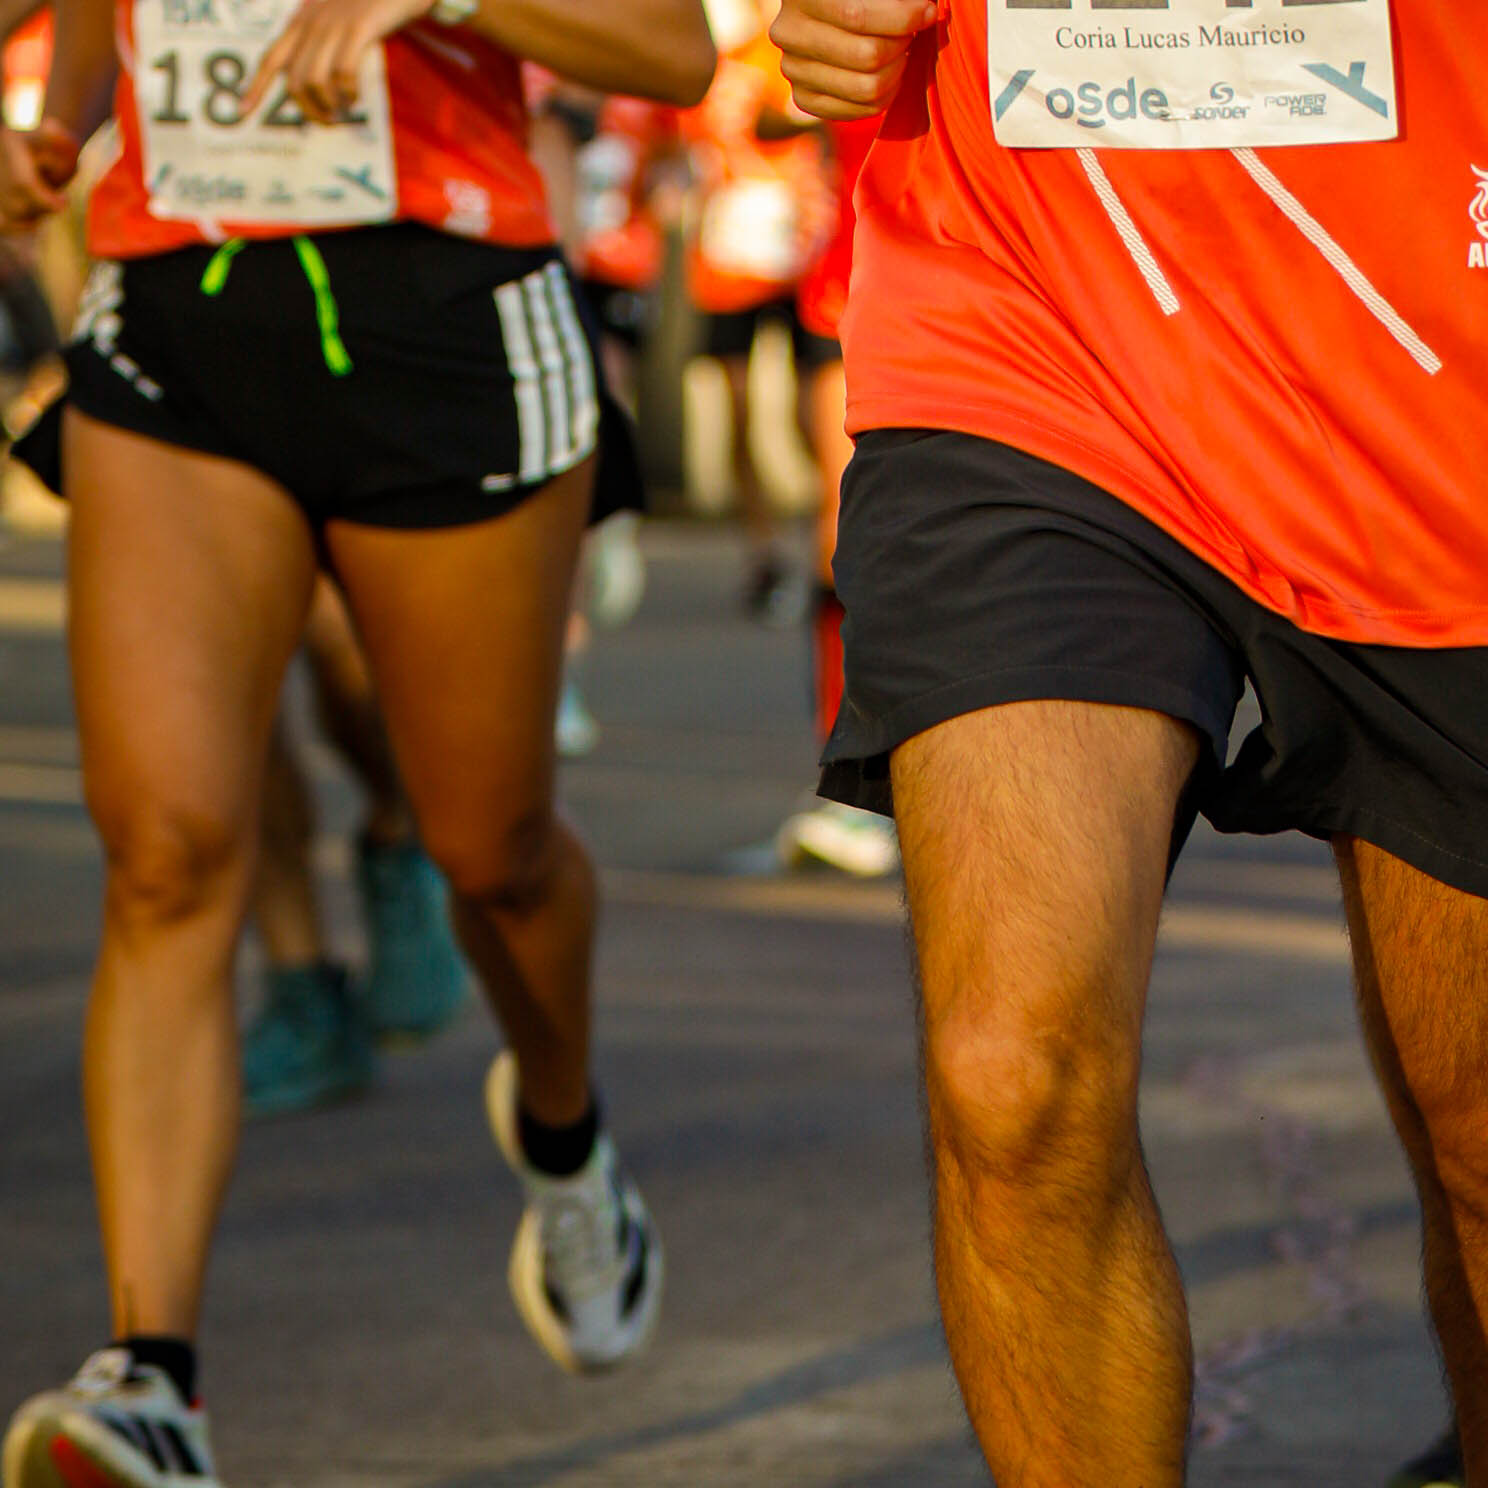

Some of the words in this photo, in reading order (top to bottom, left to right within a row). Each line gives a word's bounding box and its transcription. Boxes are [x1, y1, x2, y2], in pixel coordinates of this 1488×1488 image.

[1055, 26, 1117, 49] Coria
[1123, 26, 1191, 49] Lucas
[1198, 23, 1306, 48] Mauricio
[1044, 76, 1169, 124] osde
